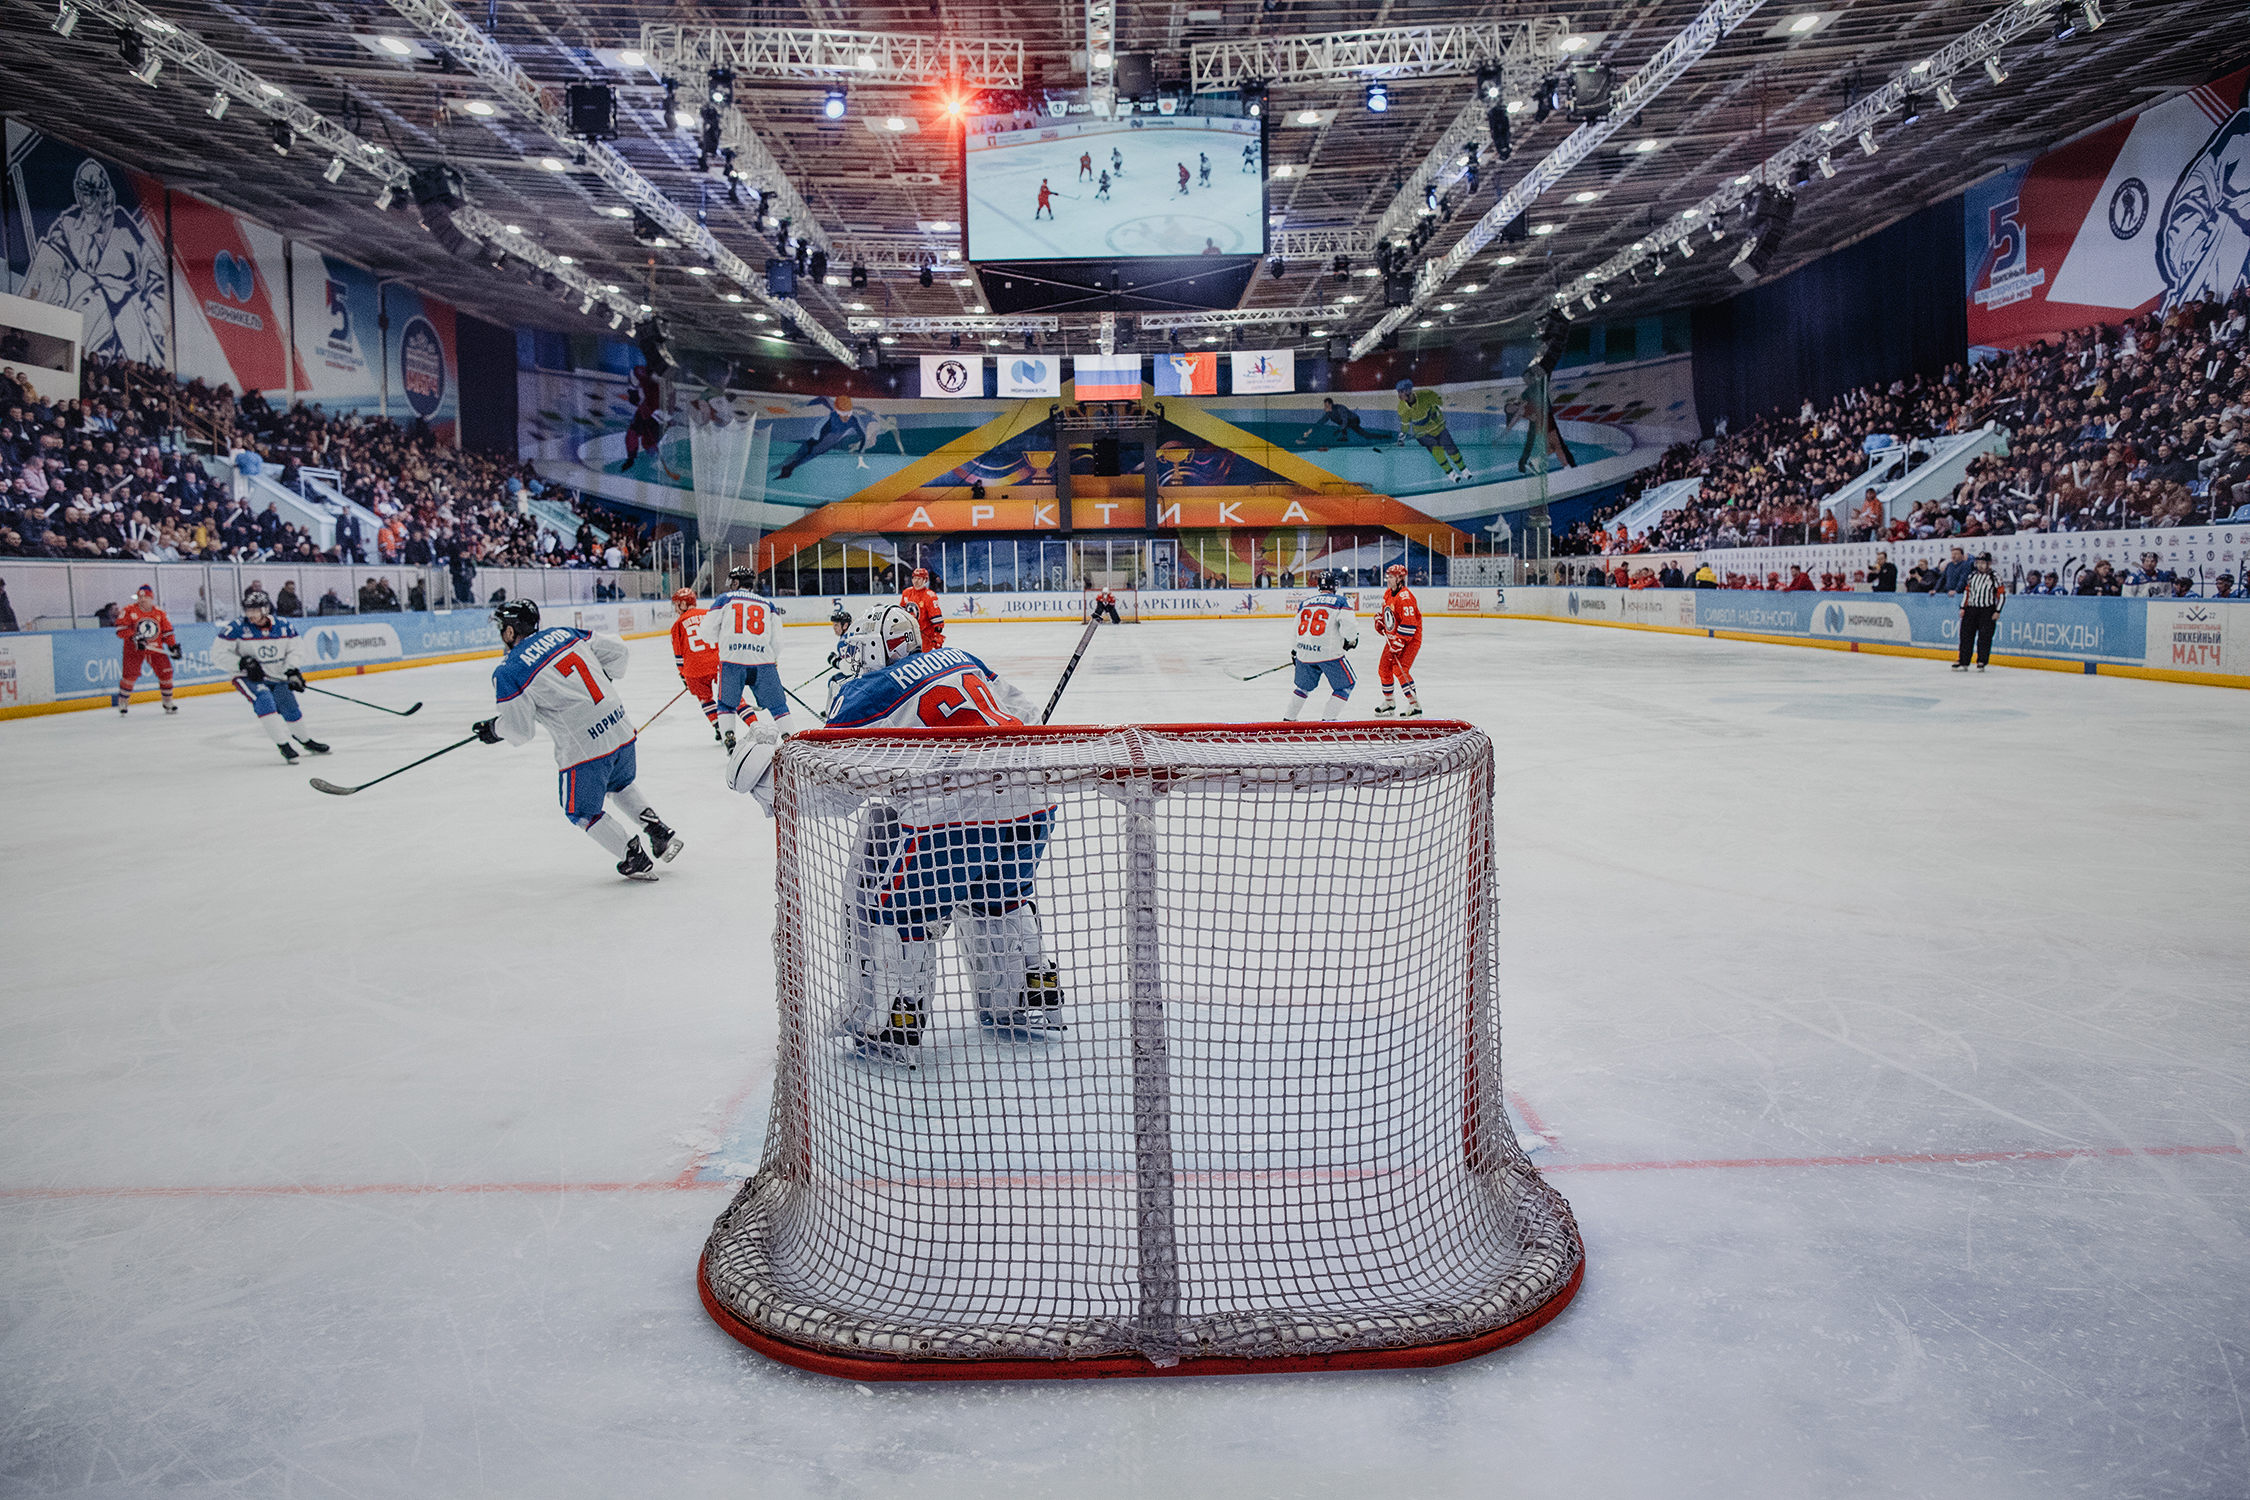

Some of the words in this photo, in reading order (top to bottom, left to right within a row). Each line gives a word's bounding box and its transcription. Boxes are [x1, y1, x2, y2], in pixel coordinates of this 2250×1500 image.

[907, 501, 1310, 528] АРКТИКА
[1448, 599, 1480, 609] МАШИНА
[1497, 589, 1505, 604] 5
[1001, 600, 1063, 613] ДВОРЕЦ
[1403, 606, 1415, 616] 32
[731, 603, 765, 636] 18
[1298, 608, 1329, 636] 66
[1849, 615, 1894, 628] НОРНИКЕЛЬ
[904, 631, 915, 643] 80
[2011, 622, 2099, 650] НАДЕЖДЫ
[2172, 631, 2222, 644] ХОККЕЙНЫЙ
[519, 628, 572, 667] АСКАРОВ
[729, 643, 766, 653] НОРИЛЬСК
[2172, 643, 2221, 667] МАТЧ
[553, 651, 605, 706] 7
